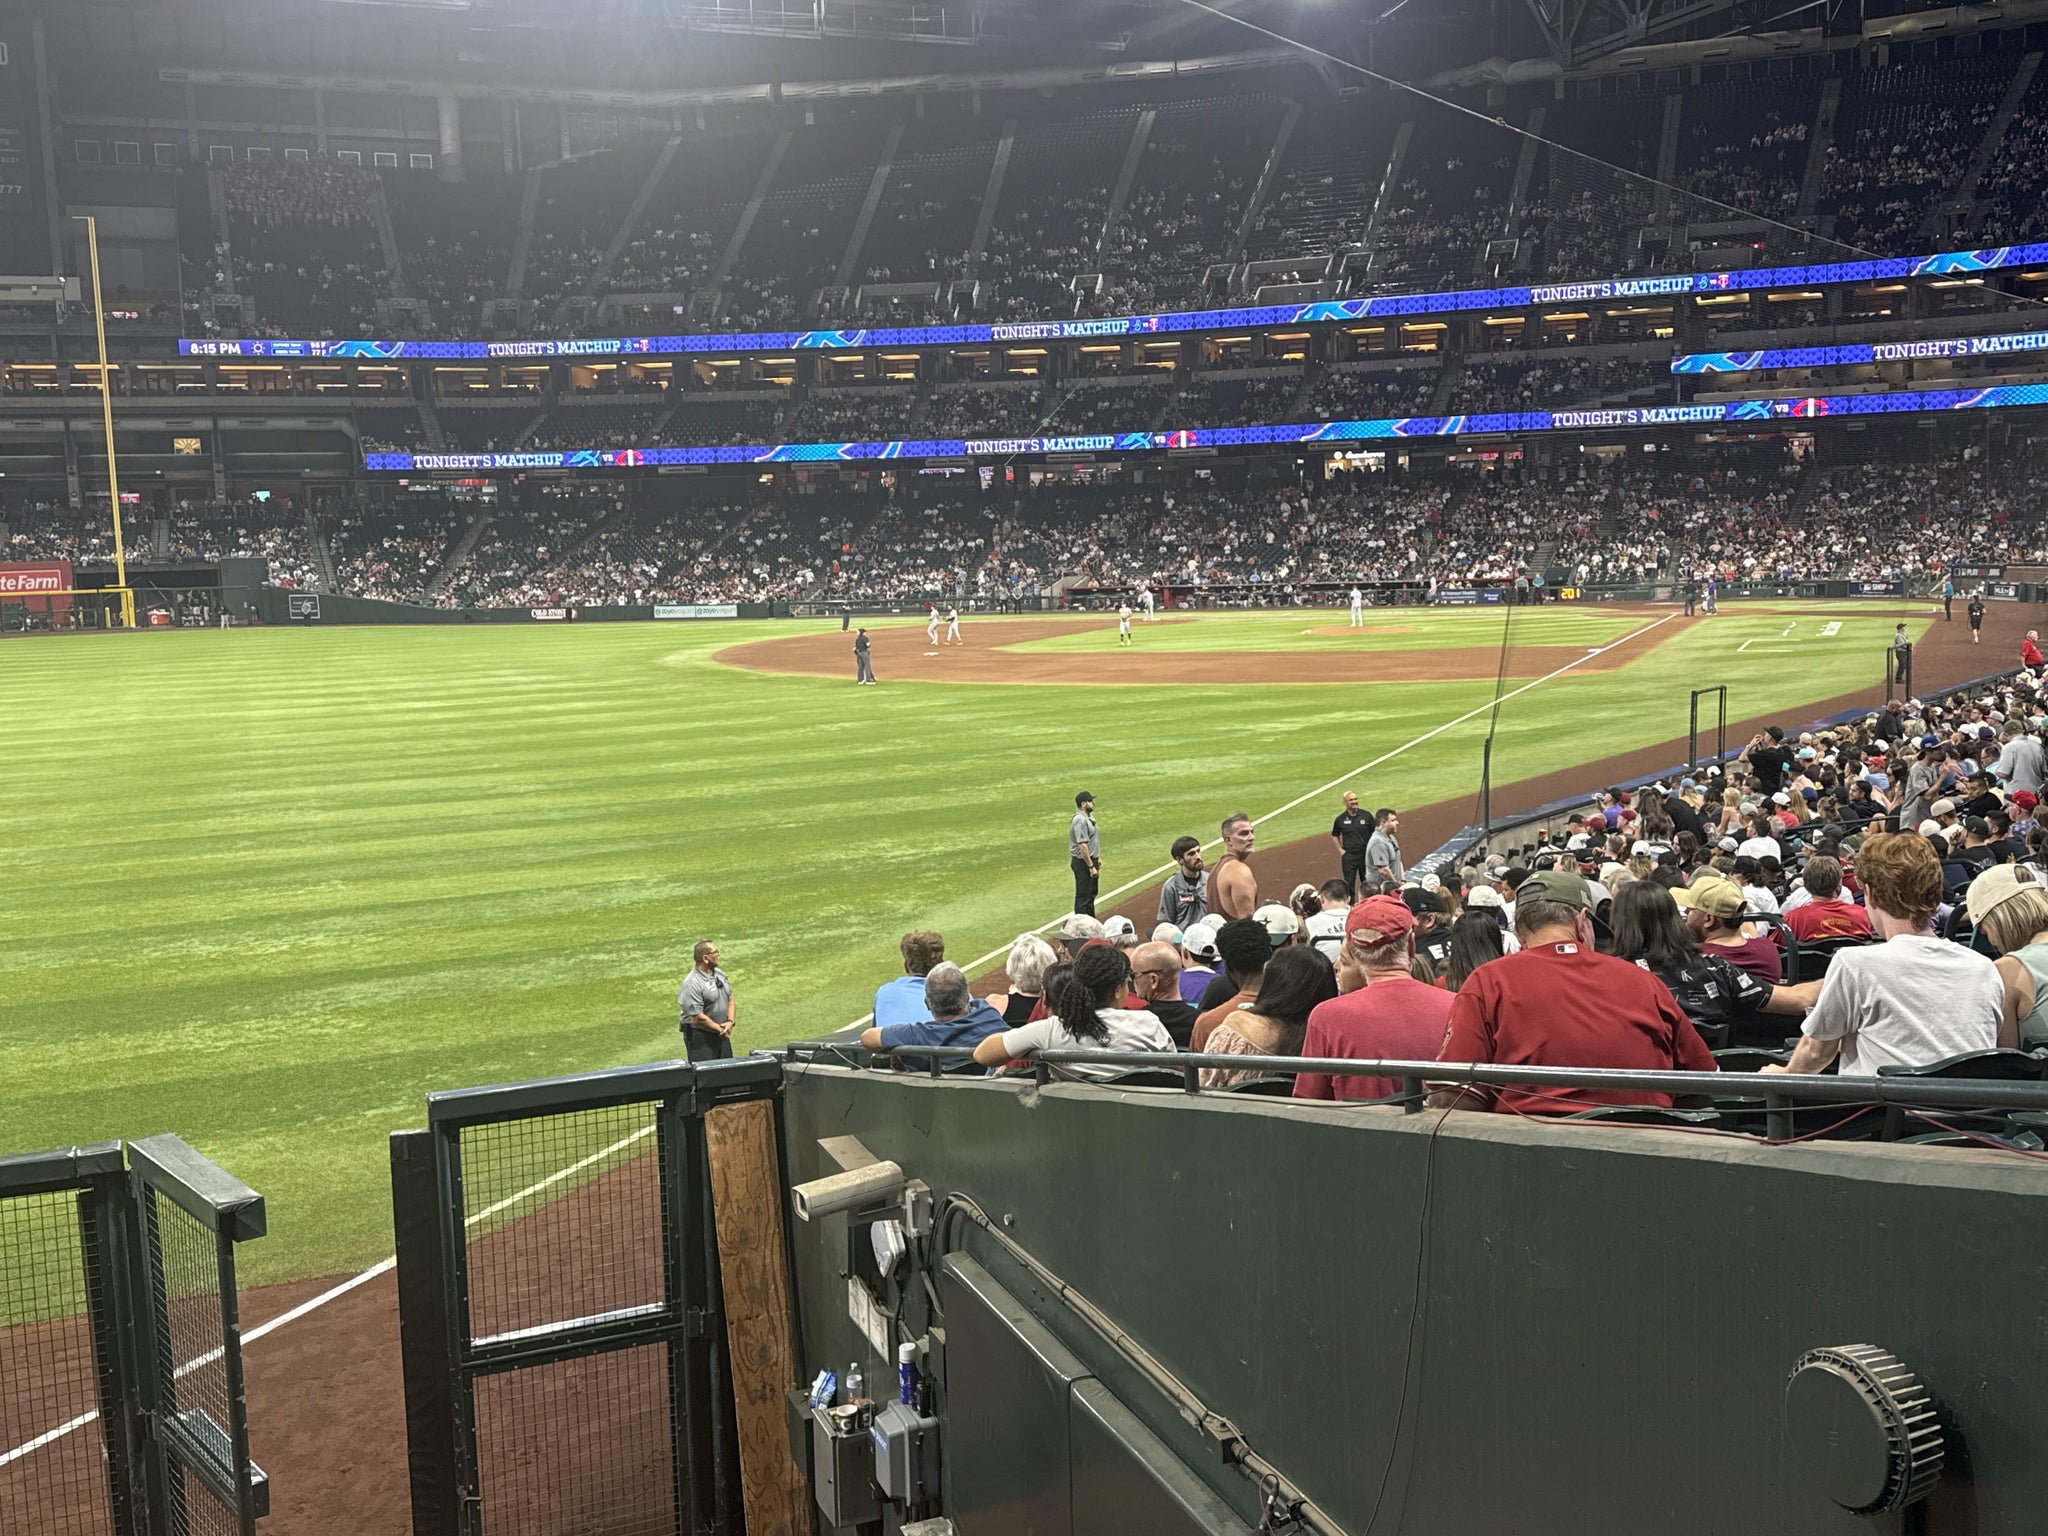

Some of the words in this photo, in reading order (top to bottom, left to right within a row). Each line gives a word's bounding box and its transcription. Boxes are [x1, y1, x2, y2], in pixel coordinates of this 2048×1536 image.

[1531, 283, 1611, 302] TONIGHT'S
[1614, 277, 1693, 296] MATCHUP
[991, 324, 1060, 339] TONIGHT'S
[1063, 320, 1129, 336] MATCHUP
[190, 343, 216, 354] 8:15
[220, 343, 241, 354] PM
[488, 342, 554, 356] TONIGHT'S
[557, 340, 621, 354] MATCHUP
[1873, 339, 1967, 360] TONIGHT'S
[1552, 410, 1637, 426] TONIGHT'S
[1640, 405, 1726, 422] MATCHUP
[1775, 404, 1789, 413] VS
[965, 438, 1040, 453] TONIGHT'S
[1043, 436, 1114, 450] MATCHUP
[413, 454, 492, 468] TONIGHT'S
[494, 453, 563, 467] MATCHUP
[531, 608, 547, 618] COLD
